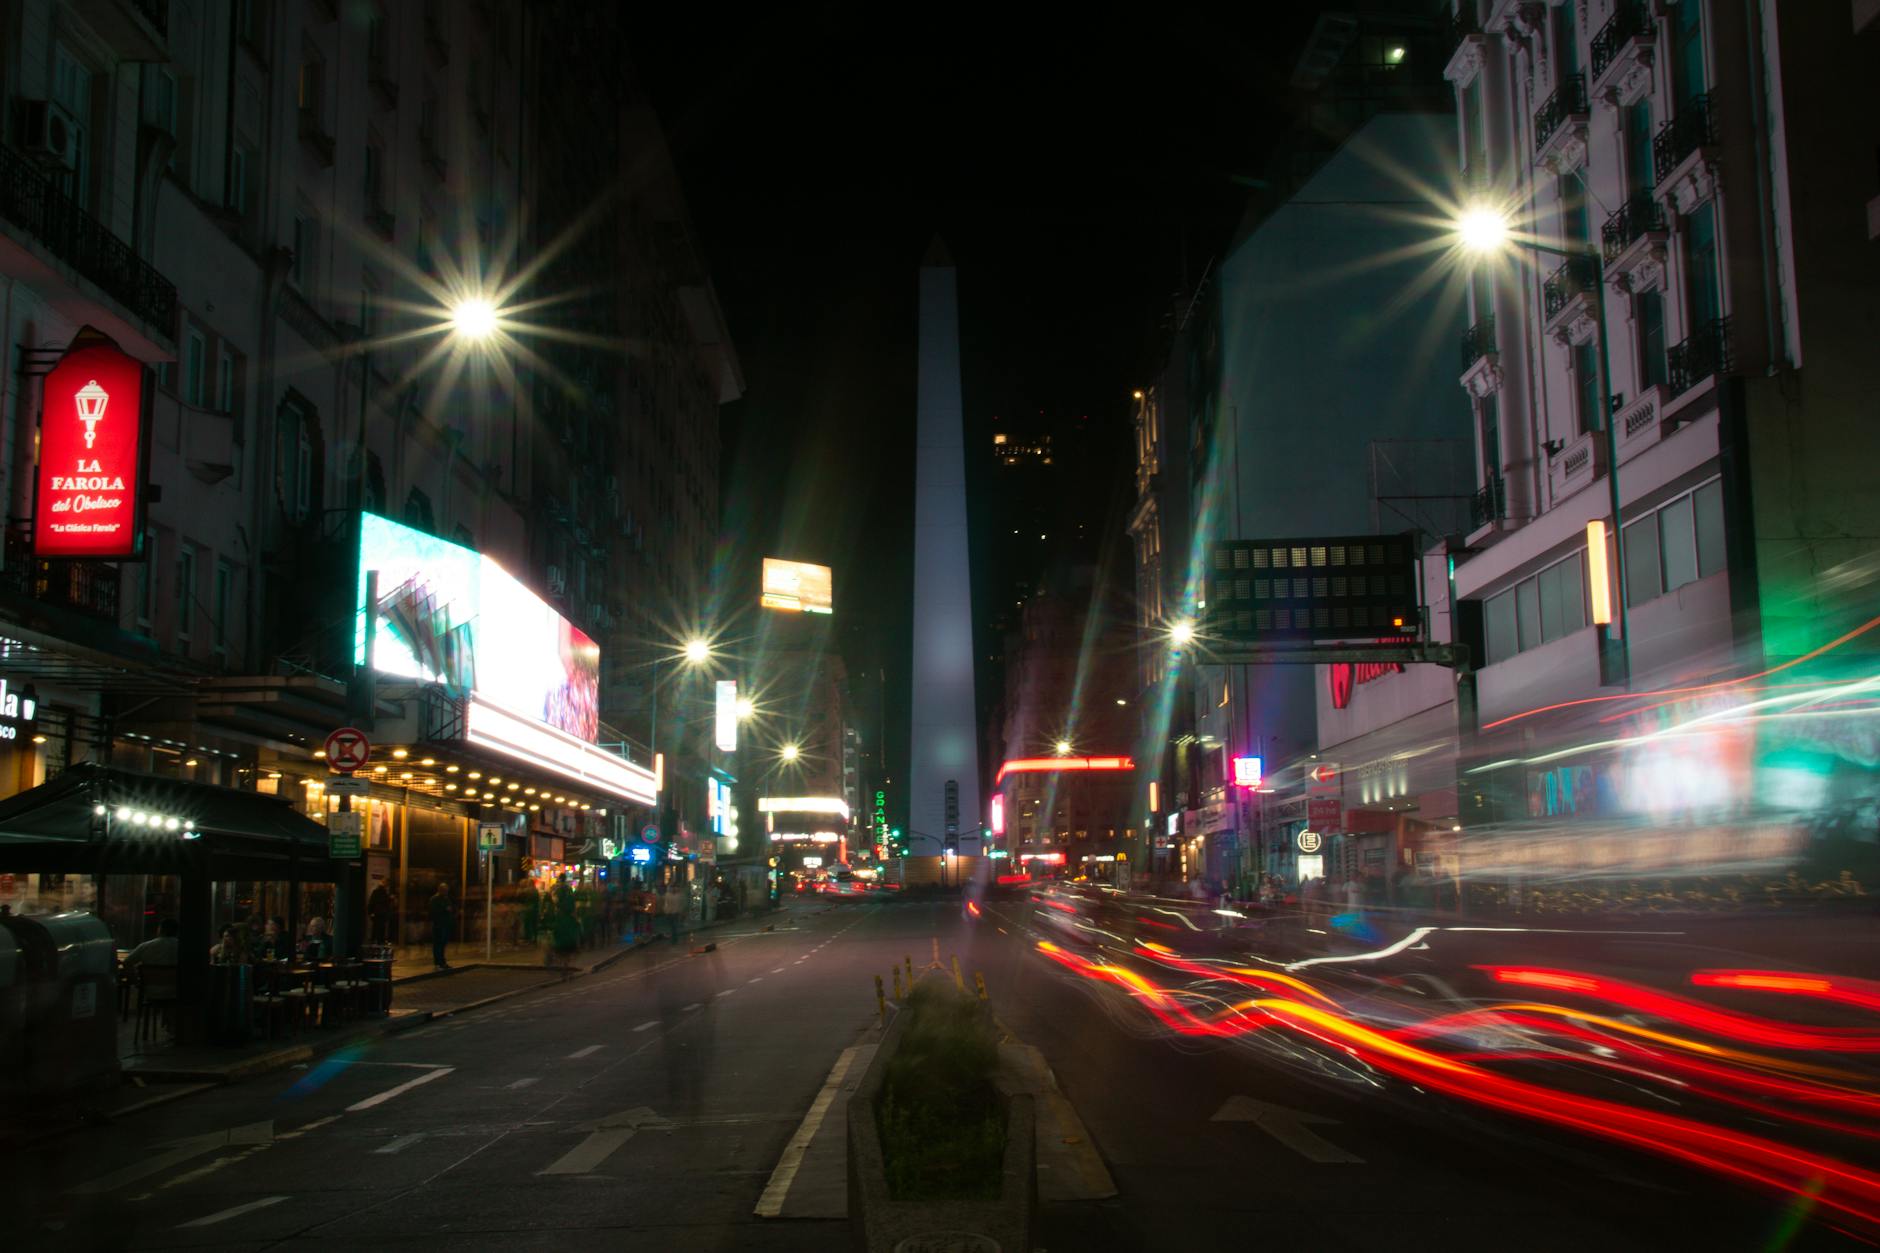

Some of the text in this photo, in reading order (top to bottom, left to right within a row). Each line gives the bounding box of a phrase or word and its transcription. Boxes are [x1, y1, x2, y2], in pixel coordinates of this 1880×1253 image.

[77, 459, 102, 473] LA
[51, 476, 125, 490] FAROLA
[52, 494, 121, 512] del Obelisco
